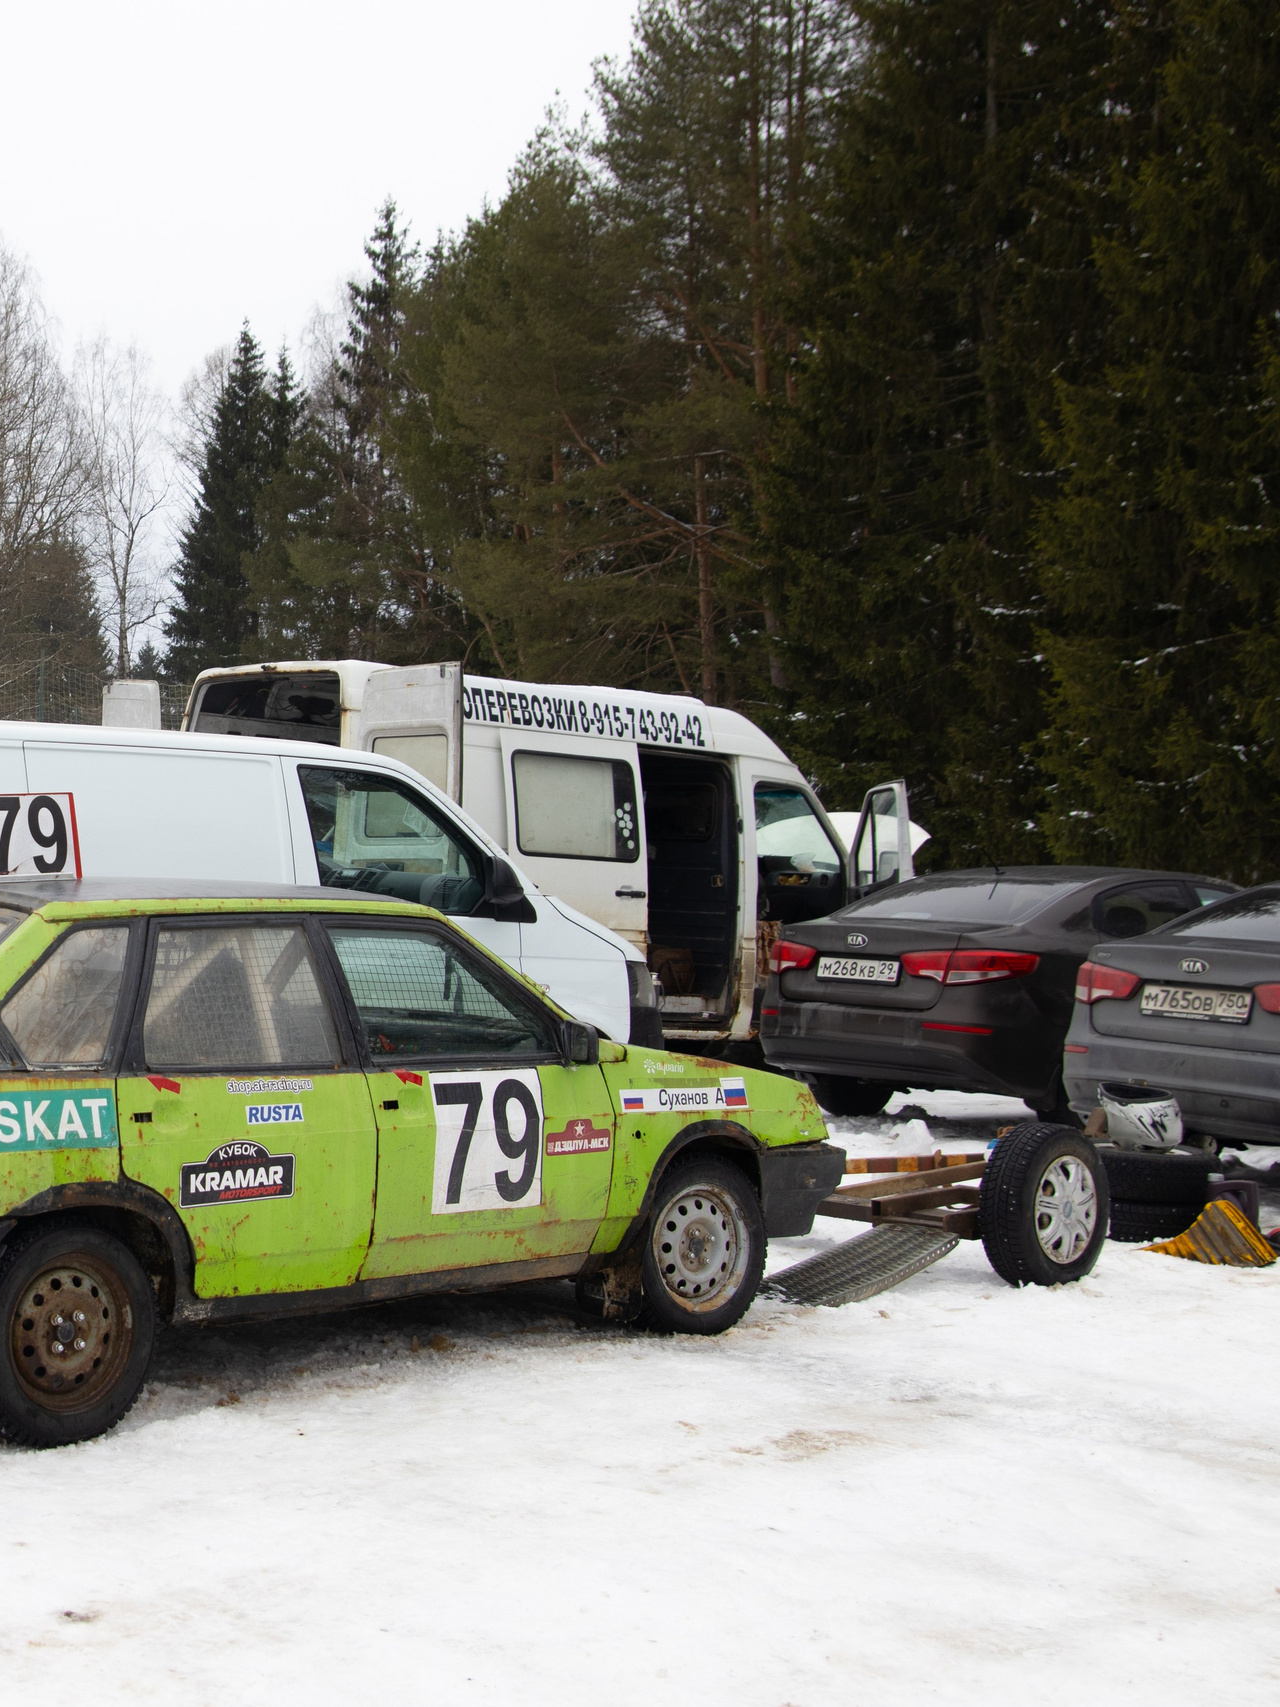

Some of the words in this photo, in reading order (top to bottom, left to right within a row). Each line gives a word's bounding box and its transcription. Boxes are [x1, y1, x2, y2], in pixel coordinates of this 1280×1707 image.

[847, 936, 863, 945] KIA
[822, 960, 876, 978] М268КВ
[879, 963, 894, 975] 29
[1182, 961, 1202, 972] KIA
[1145, 989, 1214, 1012] М765ОВ
[1218, 993, 1245, 1009] 750
[226, 1077, 313, 1096] shop.at-racing.ru
[658, 1088, 709, 1111] Суханов
[248, 1105, 303, 1123] RUSTA
[433, 1079, 540, 1205] 79
[218, 1144, 258, 1160] КУБОК
[189, 1165, 284, 1194] KRAMAR
[219, 1185, 284, 1200] MOTORSPORT
